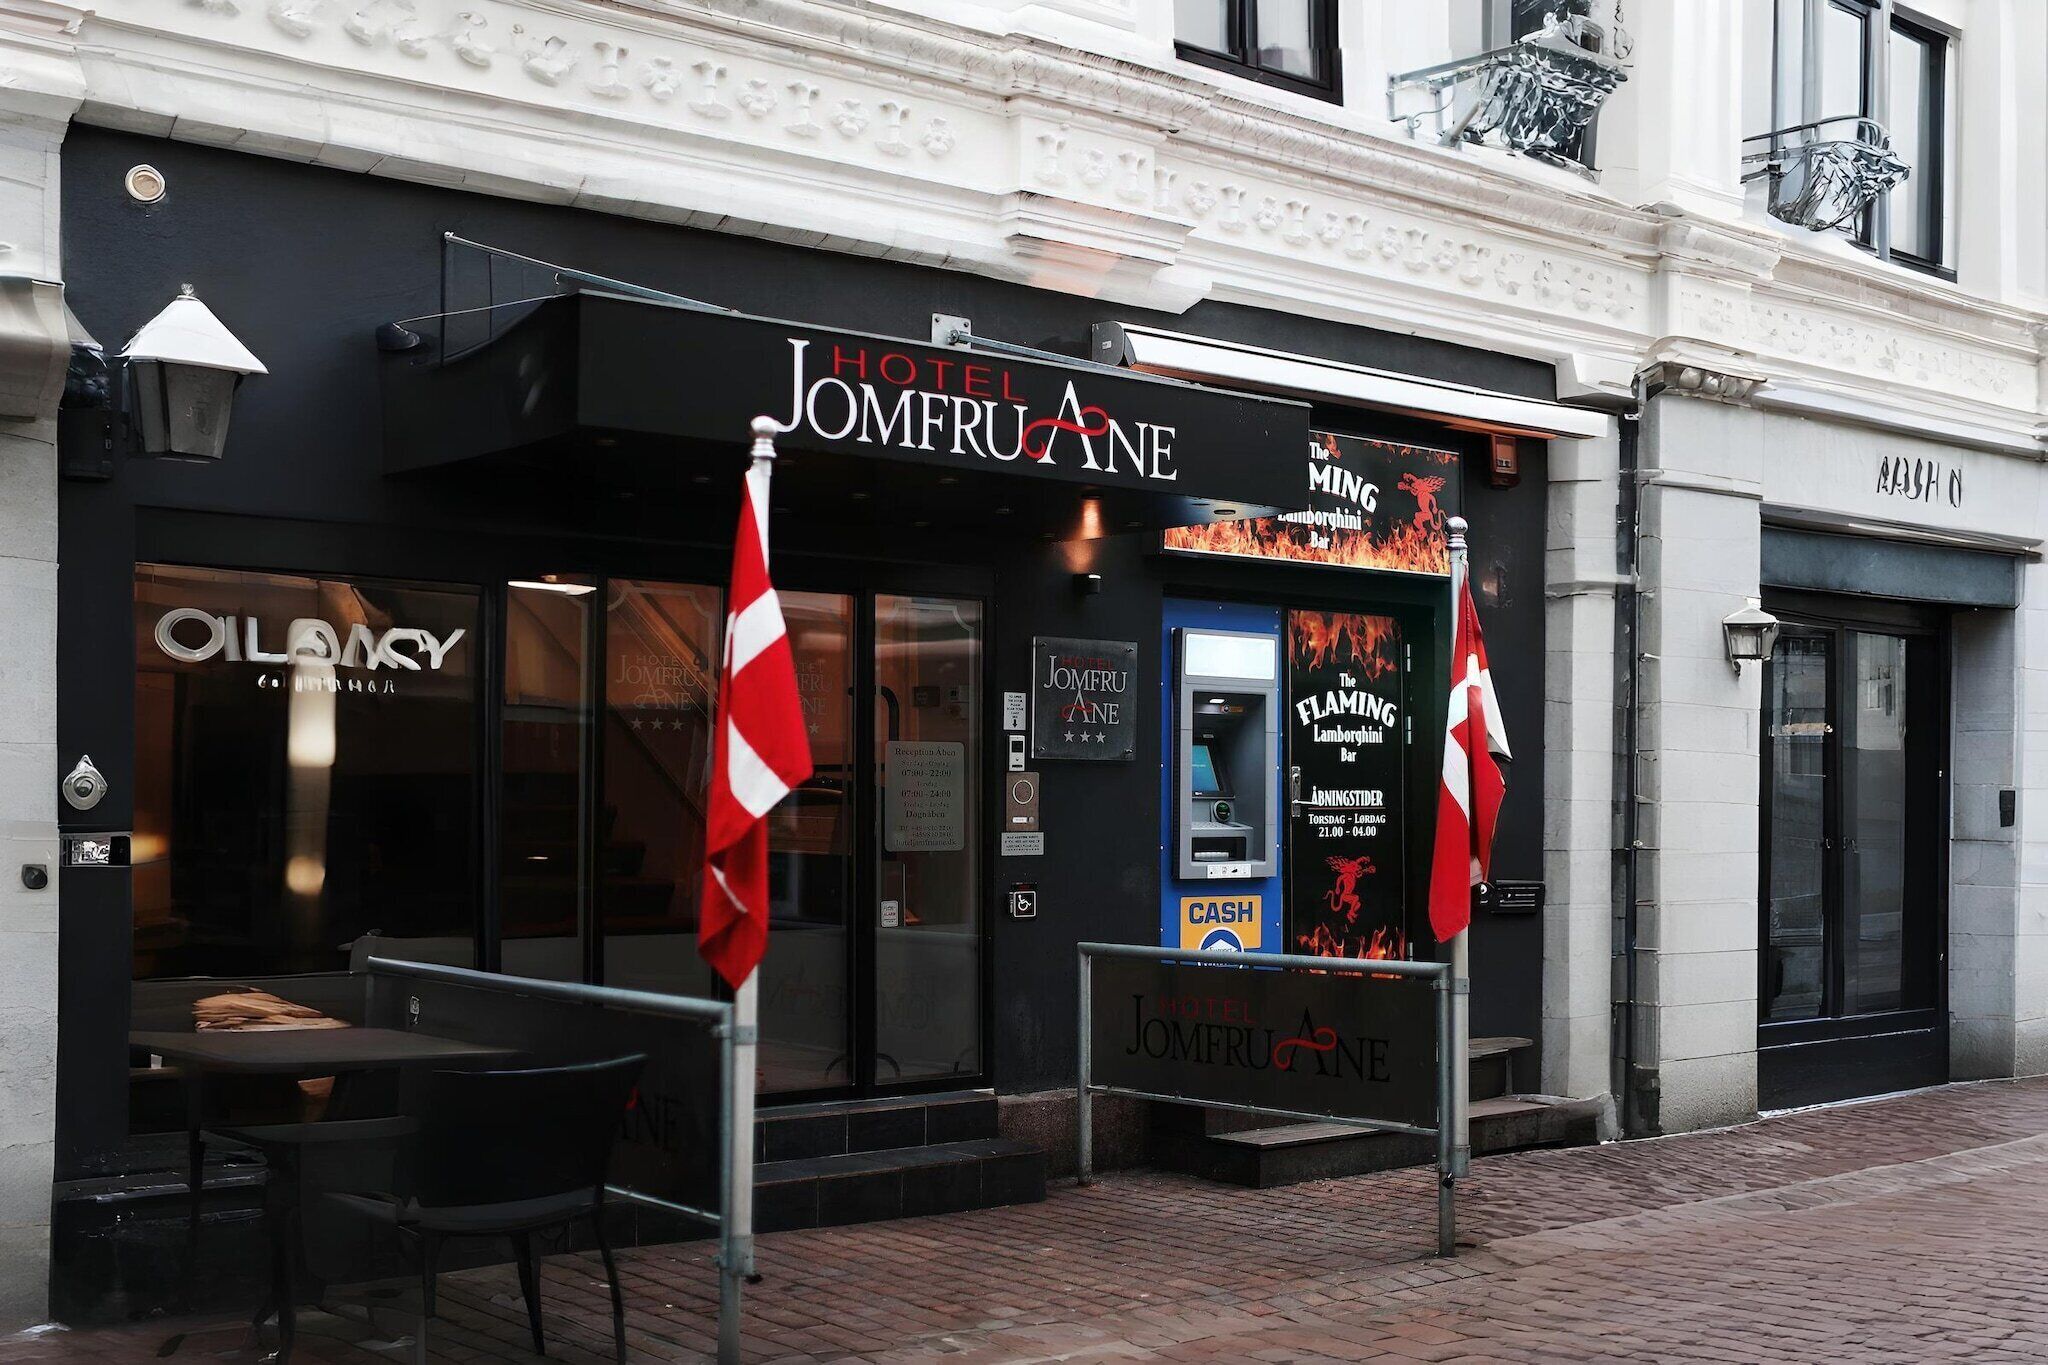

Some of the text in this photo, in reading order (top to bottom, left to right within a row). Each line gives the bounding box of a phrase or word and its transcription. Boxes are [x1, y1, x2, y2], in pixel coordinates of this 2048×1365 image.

[833, 344, 1026, 403] HOTEL
[776, 337, 1179, 481] JOMFRU ANE
[1308, 441, 1330, 461] The
[1308, 462, 1380, 514] MING
[1310, 530, 1330, 550] Bar
[1043, 655, 1128, 693] JOMFRU
[1062, 655, 1114, 671] HOTEL
[1339, 672, 1357, 688] The
[1061, 688, 1120, 725] ANE
[1296, 690, 1398, 728] FLAMING
[1313, 724, 1383, 746] Lamborghini
[1340, 747, 1357, 763] Bar
[1311, 785, 1384, 807] ÅBNINGSTIDER
[1308, 813, 1346, 825] TORSDAG
[1354, 812, 1387, 824] LØRDAG
[1318, 826, 1344, 838] 21.00
[1352, 826, 1377, 837] 04.00
[1188, 901, 1254, 925] CASH
[1159, 993, 1258, 1025] HOTEL
[1126, 994, 1392, 1083] JOMFRU ANE
